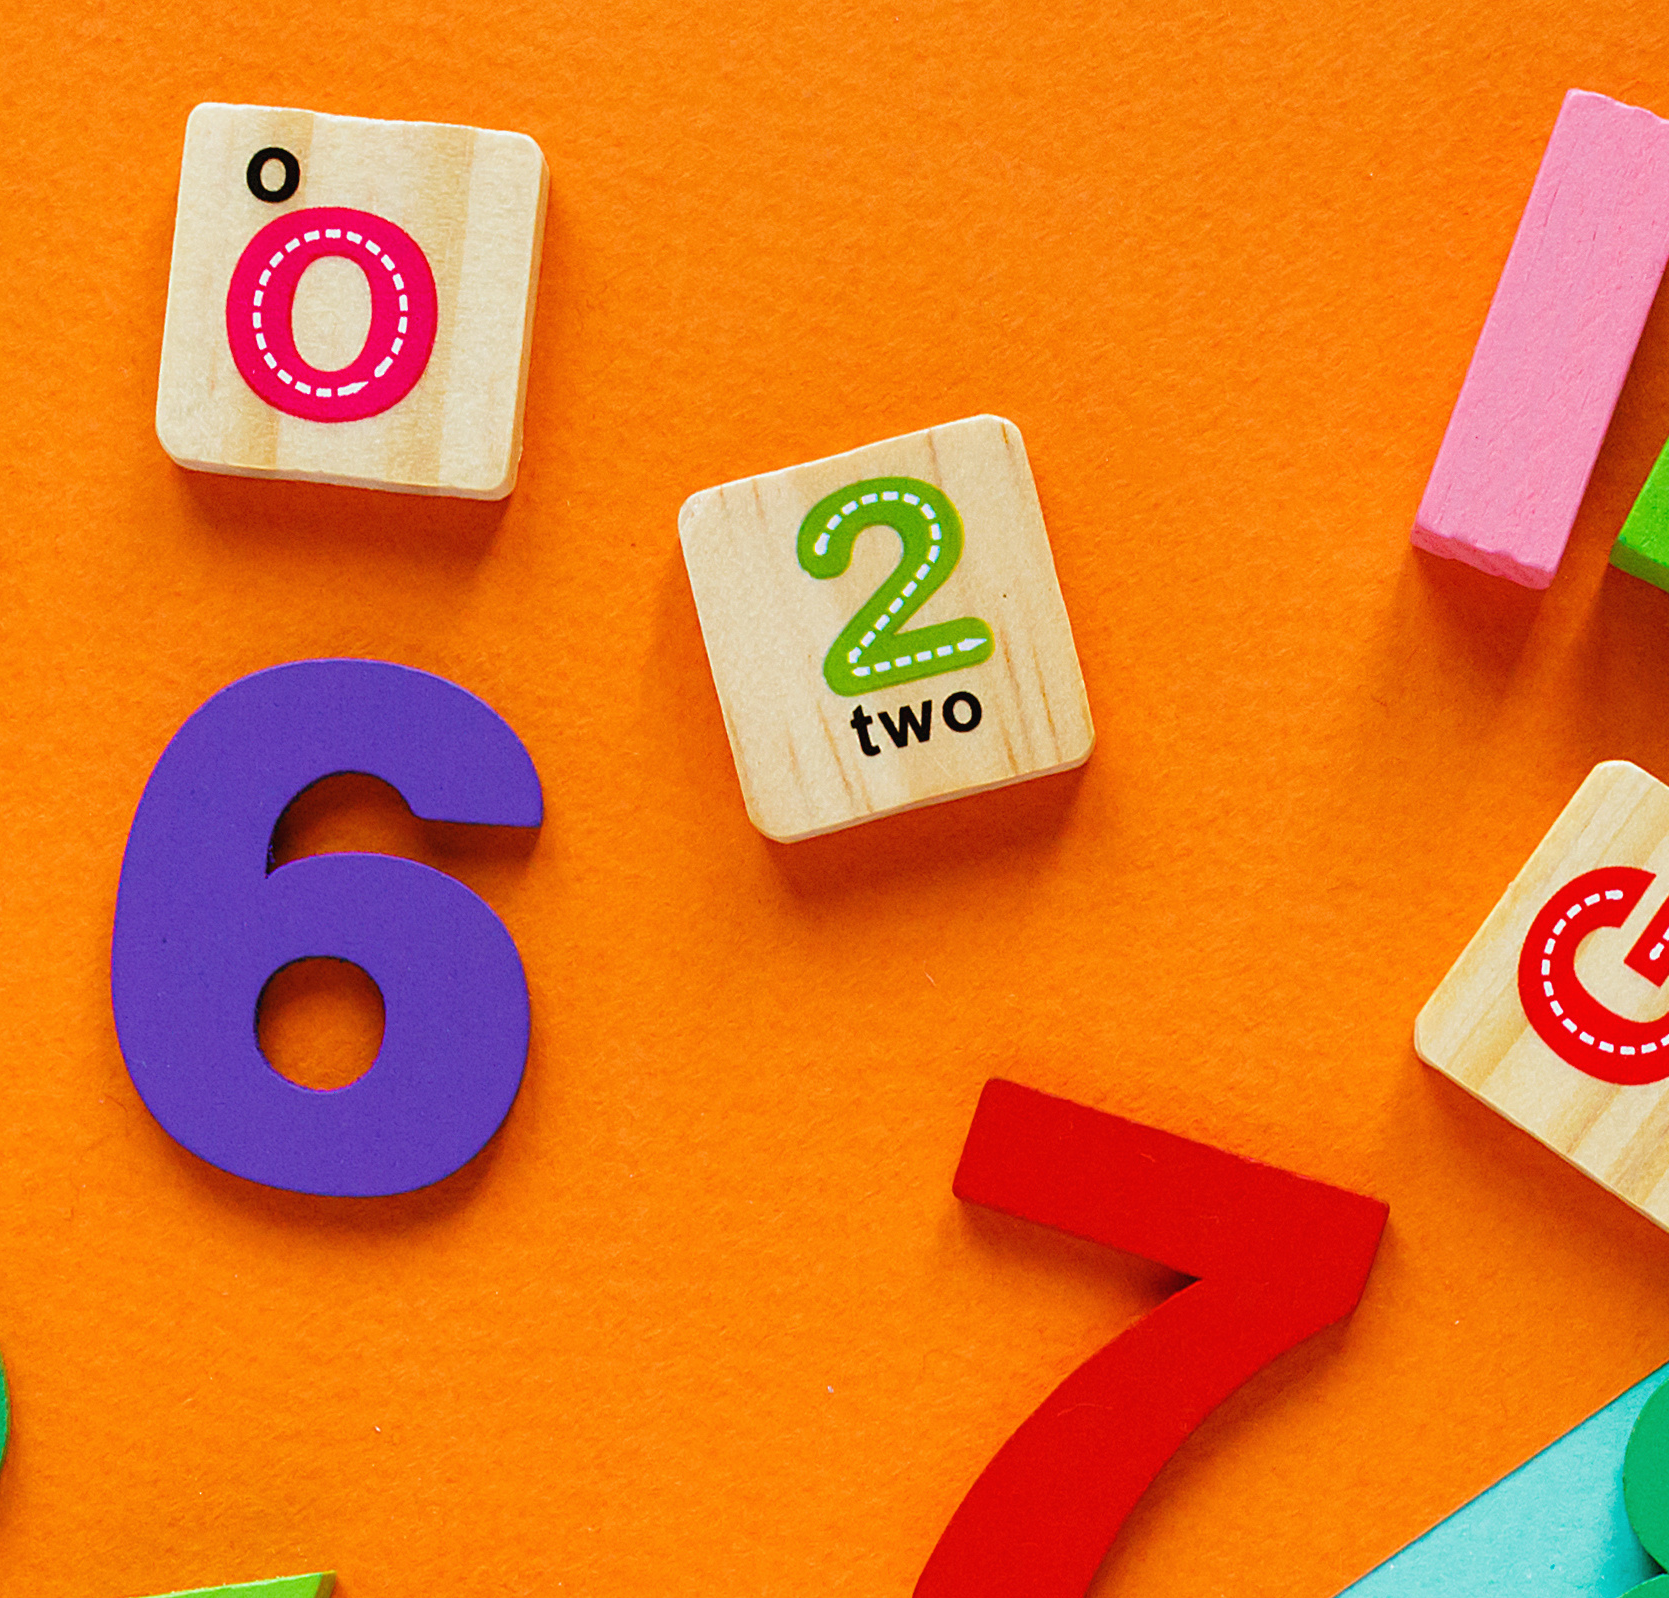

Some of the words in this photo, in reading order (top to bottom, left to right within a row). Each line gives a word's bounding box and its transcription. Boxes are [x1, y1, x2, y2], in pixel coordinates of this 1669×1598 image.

[226, 207, 438, 423] O
[798, 476, 992, 697] 2
[851, 692, 981, 756] two
[112, 659, 543, 1197] 6
